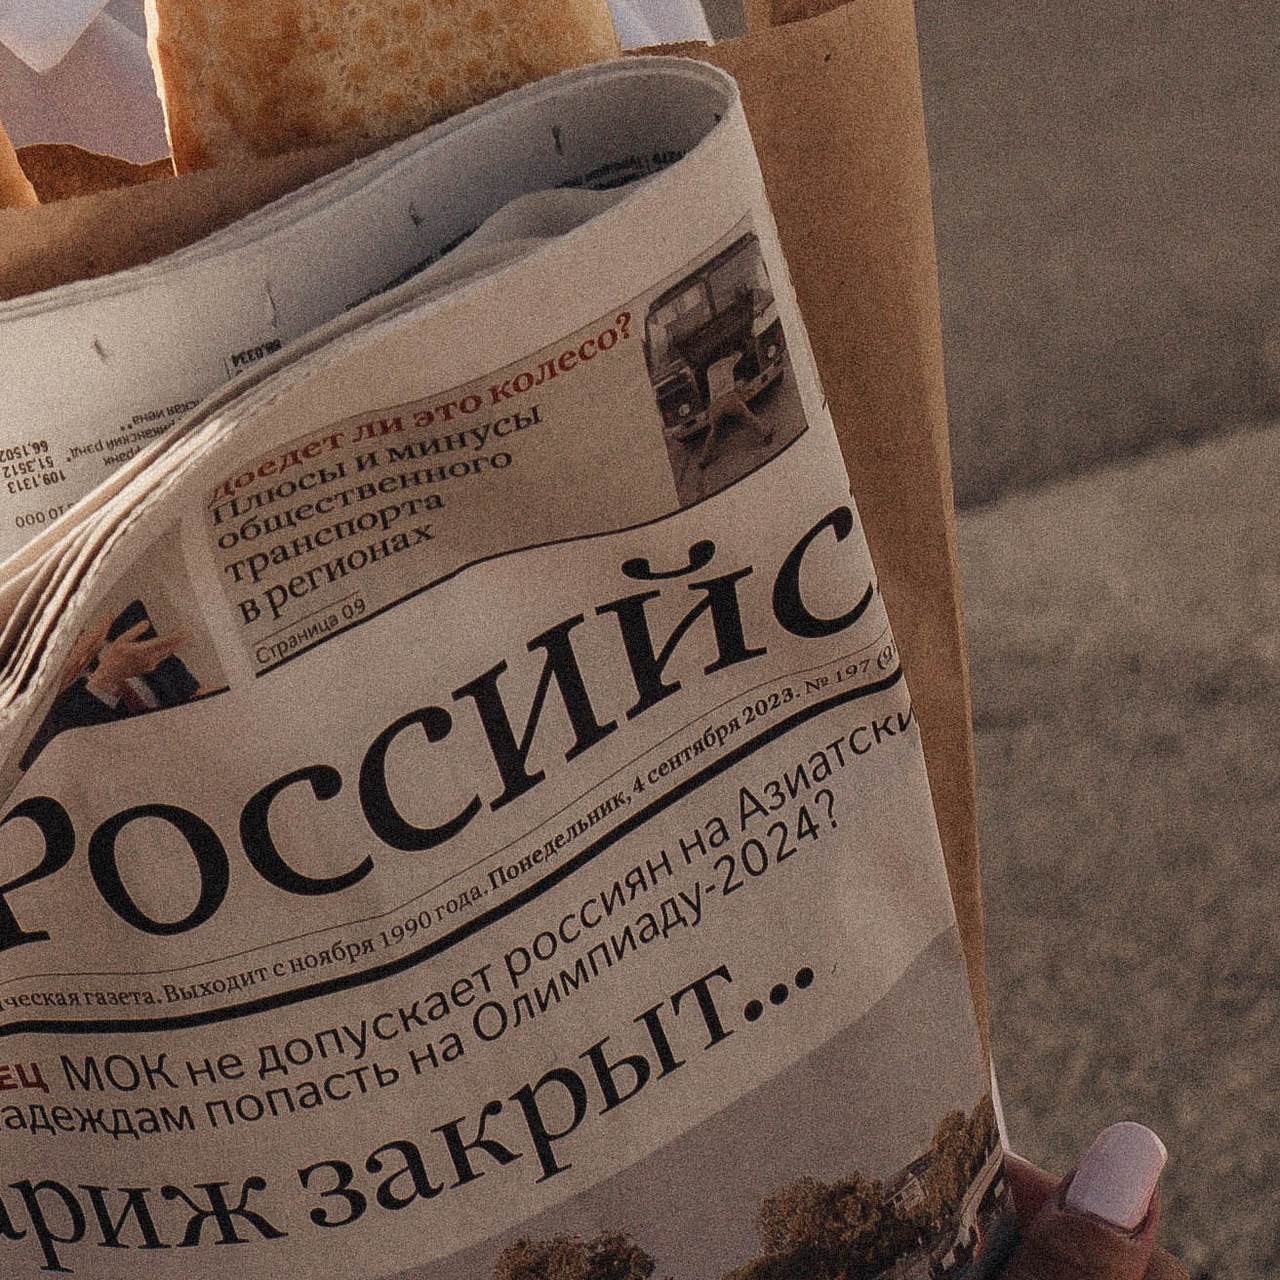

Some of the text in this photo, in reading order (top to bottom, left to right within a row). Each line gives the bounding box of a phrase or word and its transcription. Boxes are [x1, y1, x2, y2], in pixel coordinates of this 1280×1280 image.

[207, 310, 633, 508] Доедет ли это колесо?
[211, 403, 544, 527] Плюсы и минусы
[3, 455, 55, 478] 51,3512
[7, 468, 66, 494] 109,1313
[217, 451, 513, 551] общественного
[224, 493, 445, 585] транспорта
[238, 523, 436, 626] в регионах
[255, 597, 367, 665] Страница 09
[84, 987, 163, 1010] газета.
[164, 964, 268, 1004] Выходит
[272, 961, 287, 978] с
[291, 939, 376, 975] ноября
[380, 909, 433, 951] 1990
[435, 883, 490, 922] года.
[487, 789, 632, 892] Понедельник,
[631, 774, 646, 795] 4
[647, 716, 743, 786] сентября
[742, 686, 802, 726] 2023.
[805, 676, 830, 695] №
[835, 657, 871, 684] 197
[59, 1051, 180, 1094] МОК
[186, 1052, 246, 1087] не
[257, 963, 494, 1080] допускает
[504, 849, 673, 983] россиян
[683, 814, 731, 868] на
[204, 1062, 400, 1128] попасть
[408, 1031, 466, 1077] на
[472, 788, 839, 1042] Олимпиаду-2024?
[297, 961, 815, 1228] закрыт...
